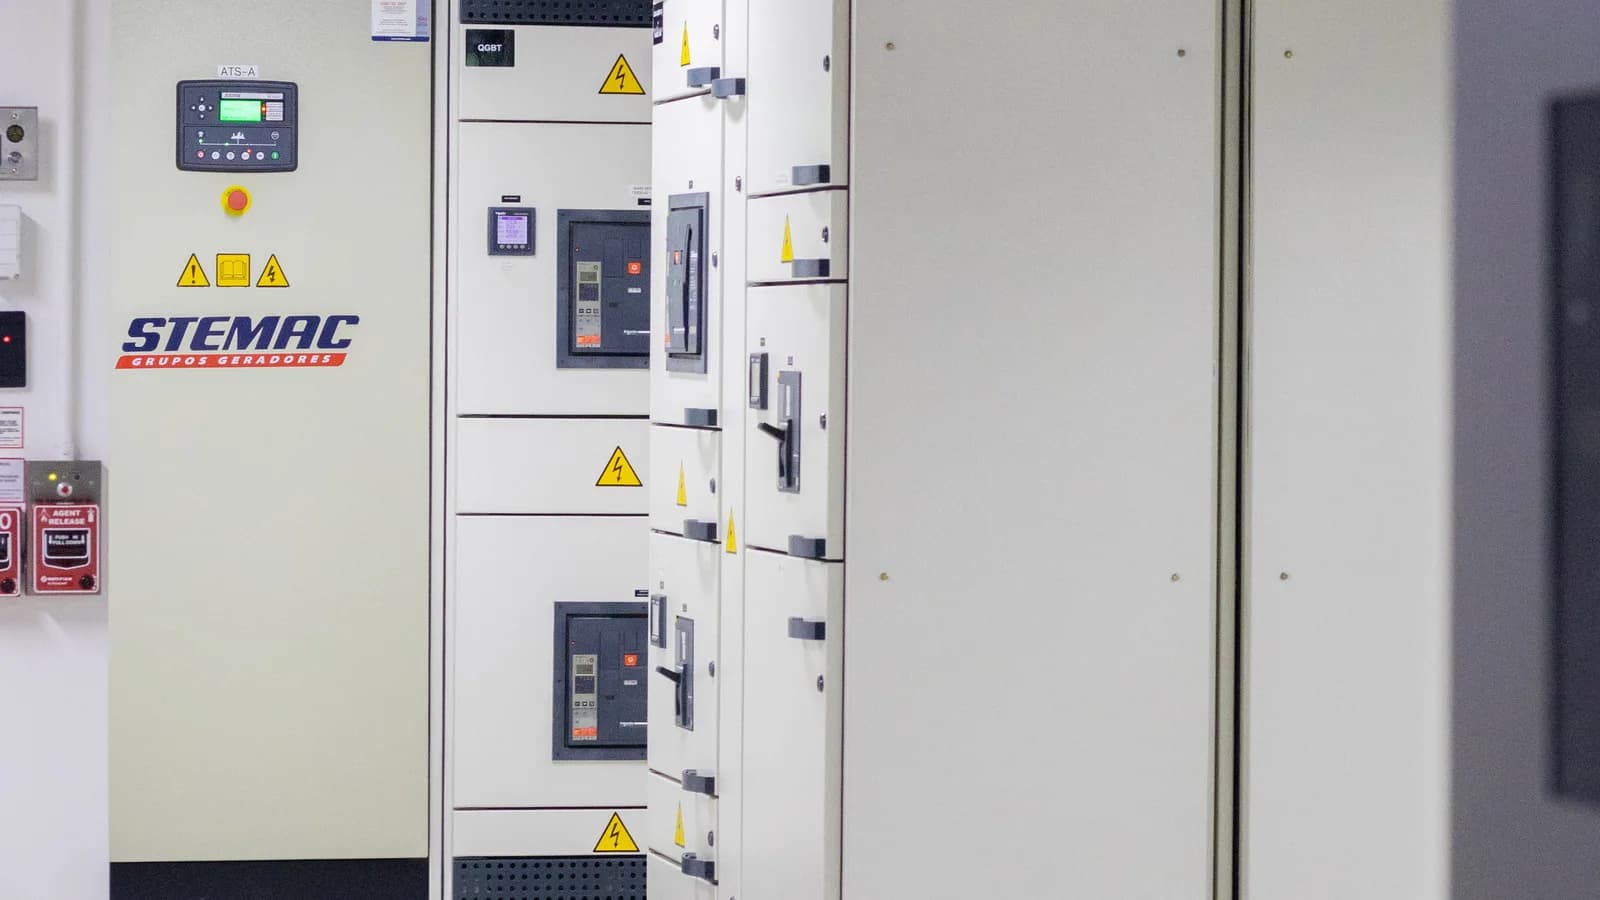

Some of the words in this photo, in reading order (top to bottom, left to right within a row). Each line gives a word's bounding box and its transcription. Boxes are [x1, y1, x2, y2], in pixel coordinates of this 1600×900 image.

[477, 43, 503, 52] QGBT
[220, 66, 256, 77] ATS-A
[121, 315, 360, 352] STEMAC
[131, 356, 208, 366] GRUPOS
[217, 354, 332, 365] GERADORES
[52, 509, 81, 517] AGENT
